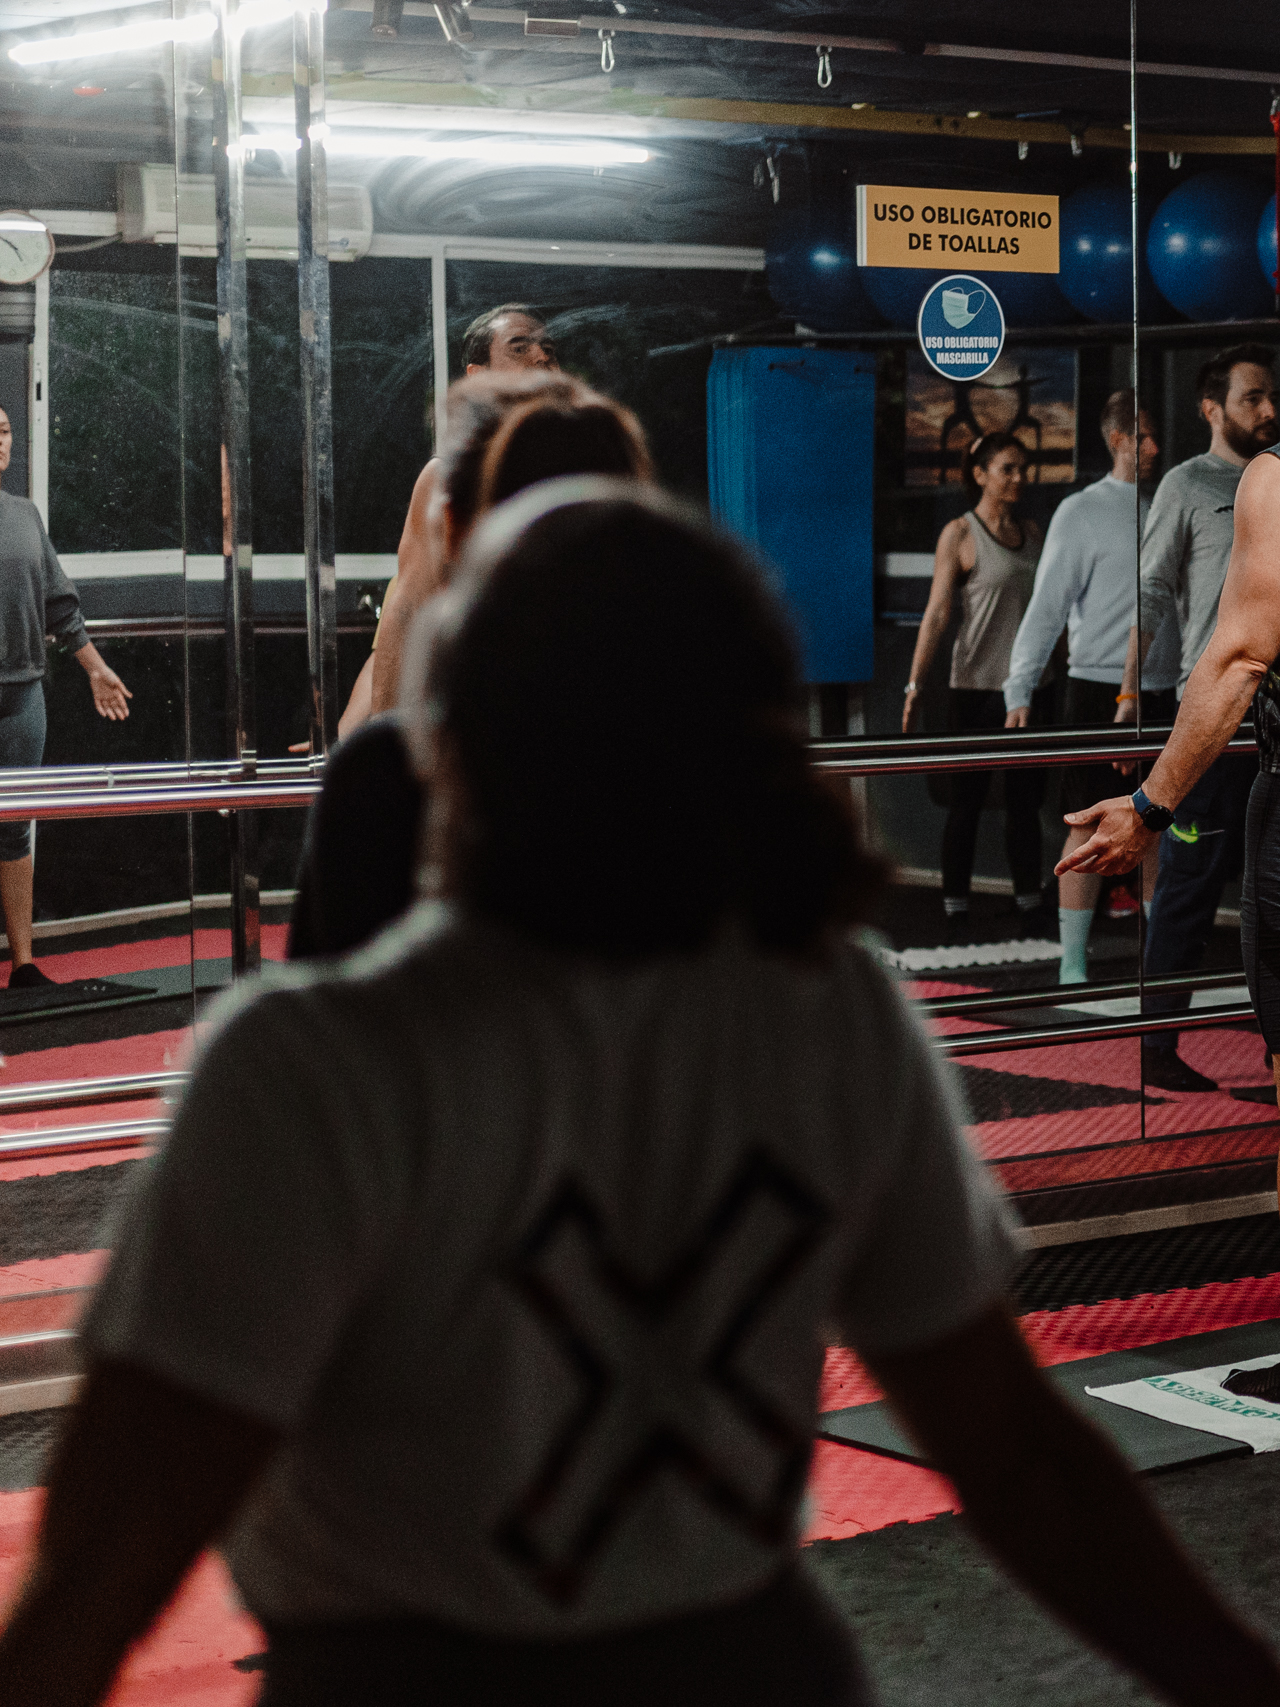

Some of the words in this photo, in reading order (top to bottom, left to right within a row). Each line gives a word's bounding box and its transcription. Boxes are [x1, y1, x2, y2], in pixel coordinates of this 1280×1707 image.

[873, 203, 915, 223] USO
[921, 205, 1052, 229] OBLIGATORIO
[908, 232, 933, 251] DE
[938, 234, 1020, 255] TOALLAS
[925, 336, 943, 349] USO
[944, 336, 999, 349] OBLIGATORIO
[936, 352, 989, 365] MASCARILLA
